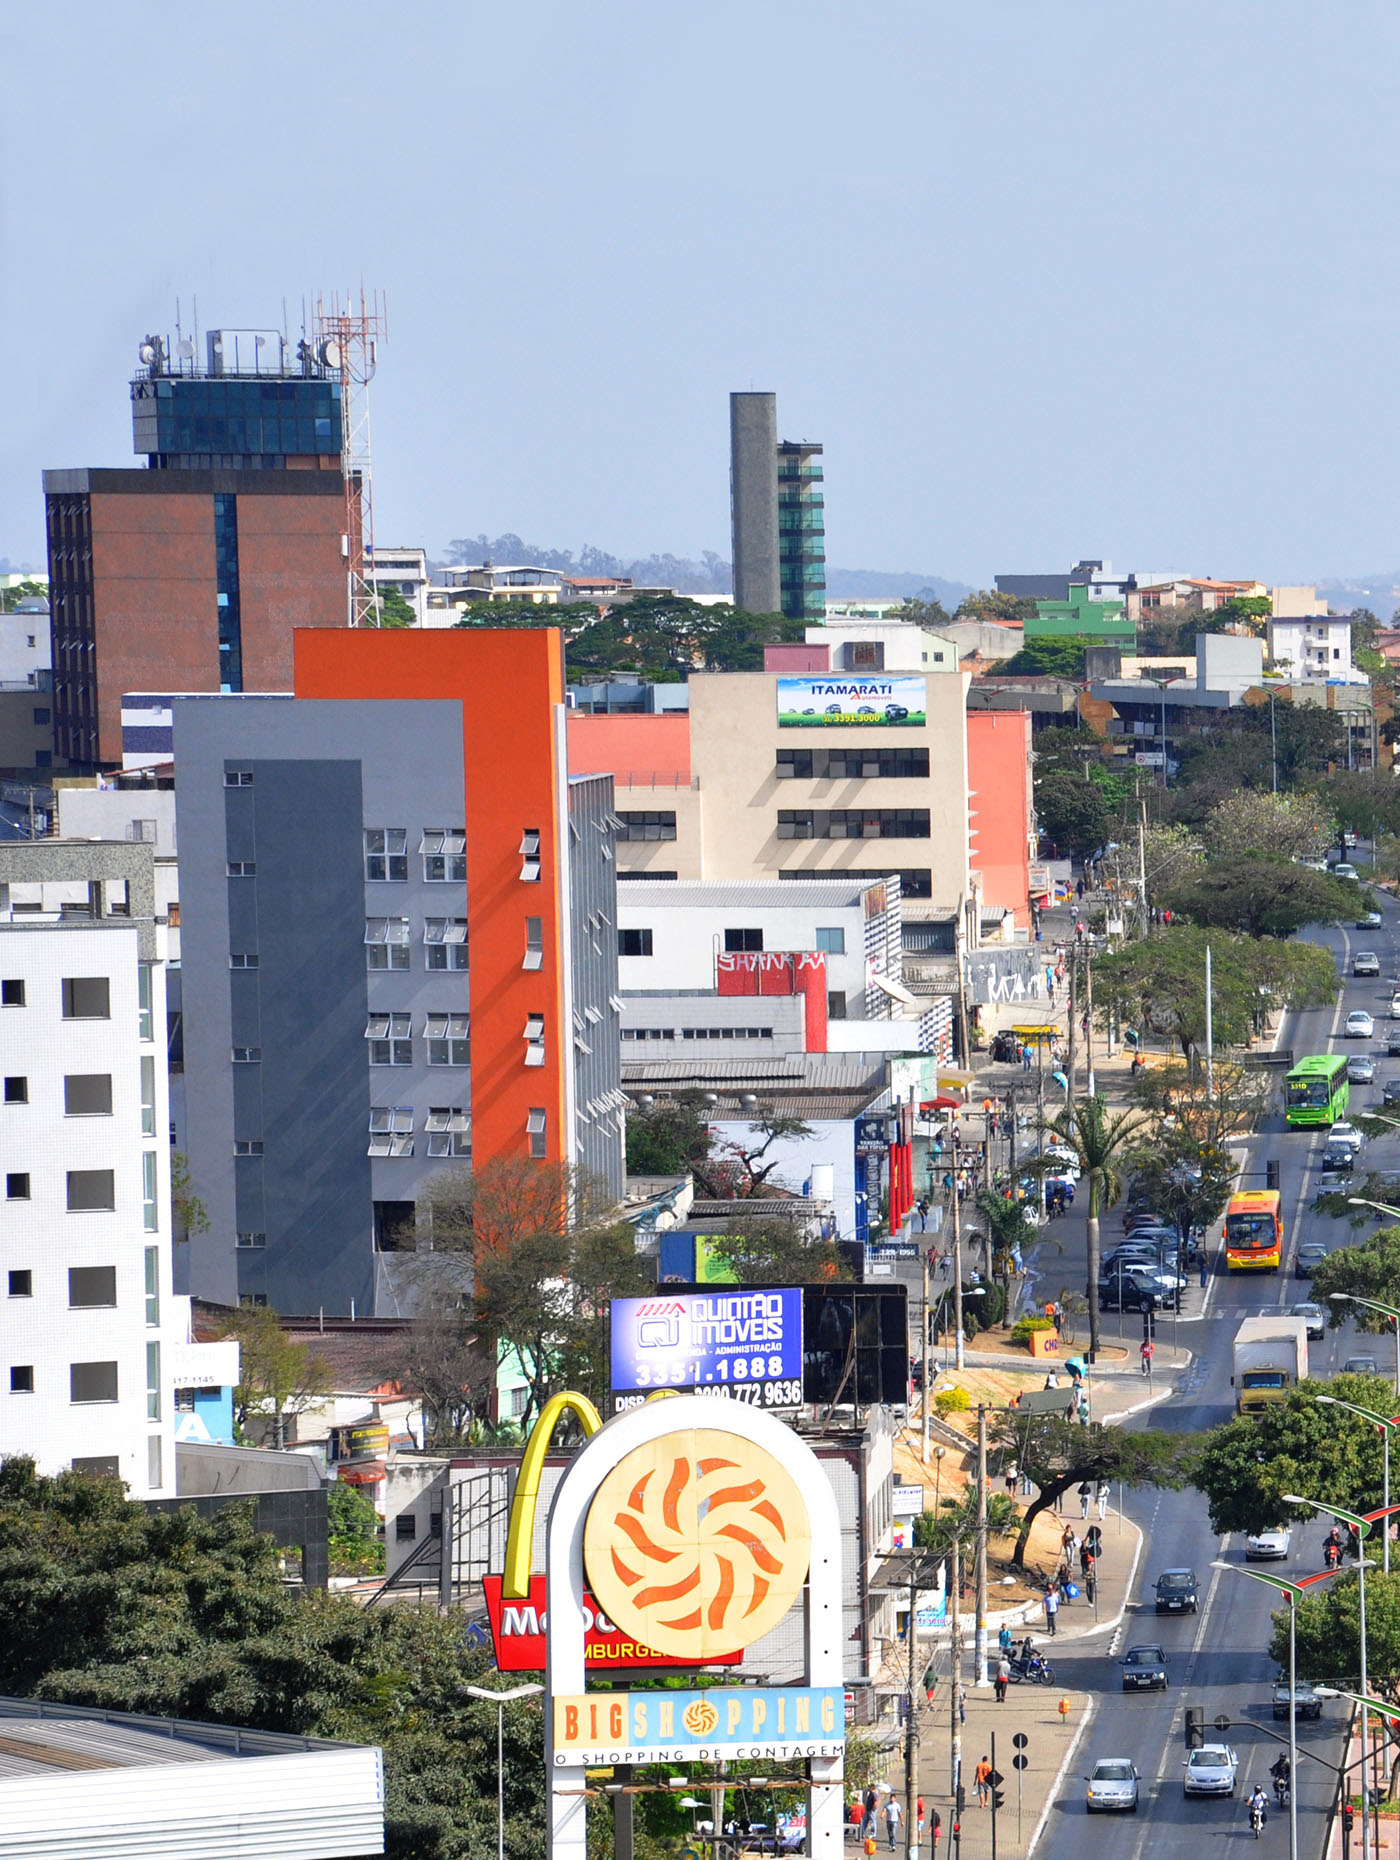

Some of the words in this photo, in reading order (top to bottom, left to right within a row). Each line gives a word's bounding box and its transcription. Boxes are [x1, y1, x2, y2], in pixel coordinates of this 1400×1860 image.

[811, 685, 892, 695] ITAMARATI
[692, 1293, 783, 1321] QUINTÃO
[692, 1316, 783, 1346] IMÓVEIS
[715, 1342, 782, 1355] ADMINISTRAÇÃO
[636, 1356, 784, 1386] 3351.1888
[734, 1383, 762, 1406] 772
[765, 1380, 801, 1405] 9636
[565, 1704, 622, 1741] BIG
[555, 1753, 567, 1765] O
[582, 1749, 684, 1765] SHOPPING
[700, 1749, 720, 1760] DE
[736, 1744, 845, 1758] CONTAGEM
